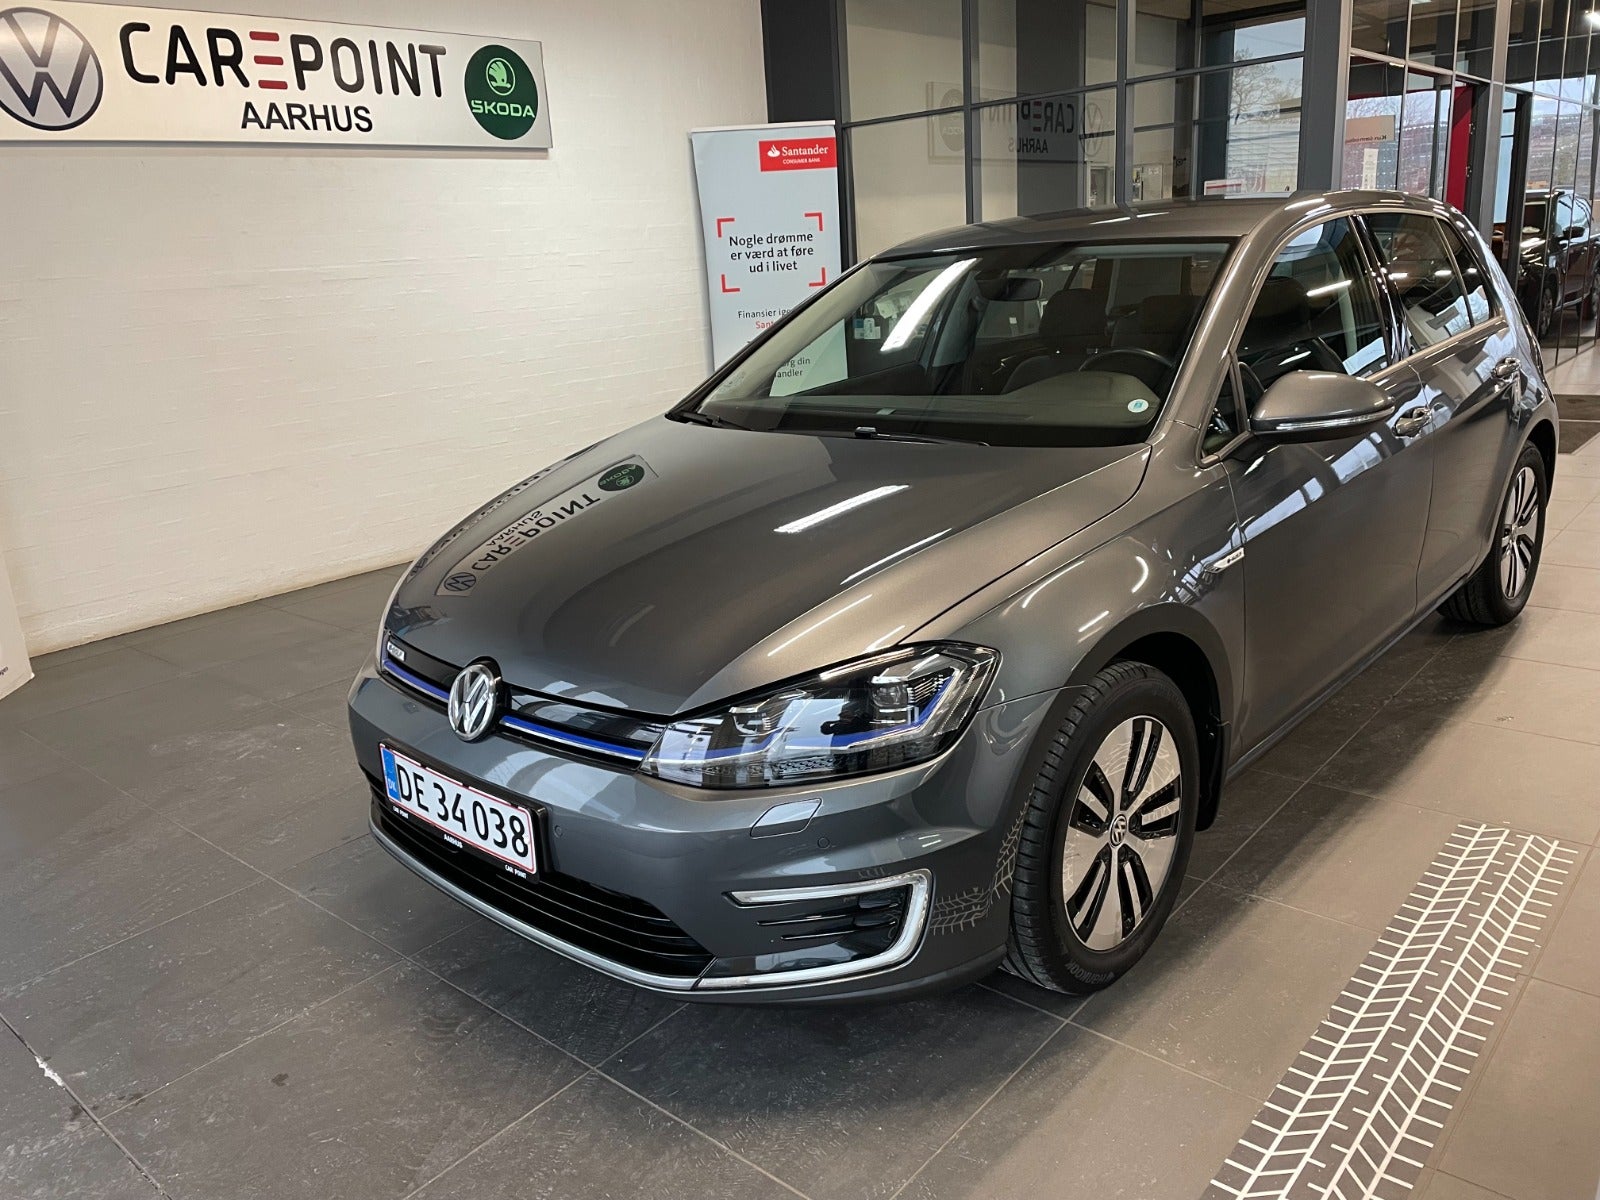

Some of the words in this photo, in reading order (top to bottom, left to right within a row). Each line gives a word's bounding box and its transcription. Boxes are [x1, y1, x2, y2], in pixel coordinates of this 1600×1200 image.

[119, 22, 447, 98] CAREPOINT
[241, 101, 373, 132] AARHUS
[781, 144, 829, 157] Santander
[729, 234, 764, 248] Nogle
[766, 233, 813, 244] drømme
[730, 252, 742, 260] er
[745, 247, 774, 260] værd
[777, 247, 789, 257] at
[791, 245, 814, 256] føre
[749, 261, 763, 273] ud
[766, 261, 770, 272] i
[772, 260, 798, 271] livet
[738, 309, 776, 319] Finansier
[797, 357, 811, 365] din
[396, 764, 429, 812] DE
